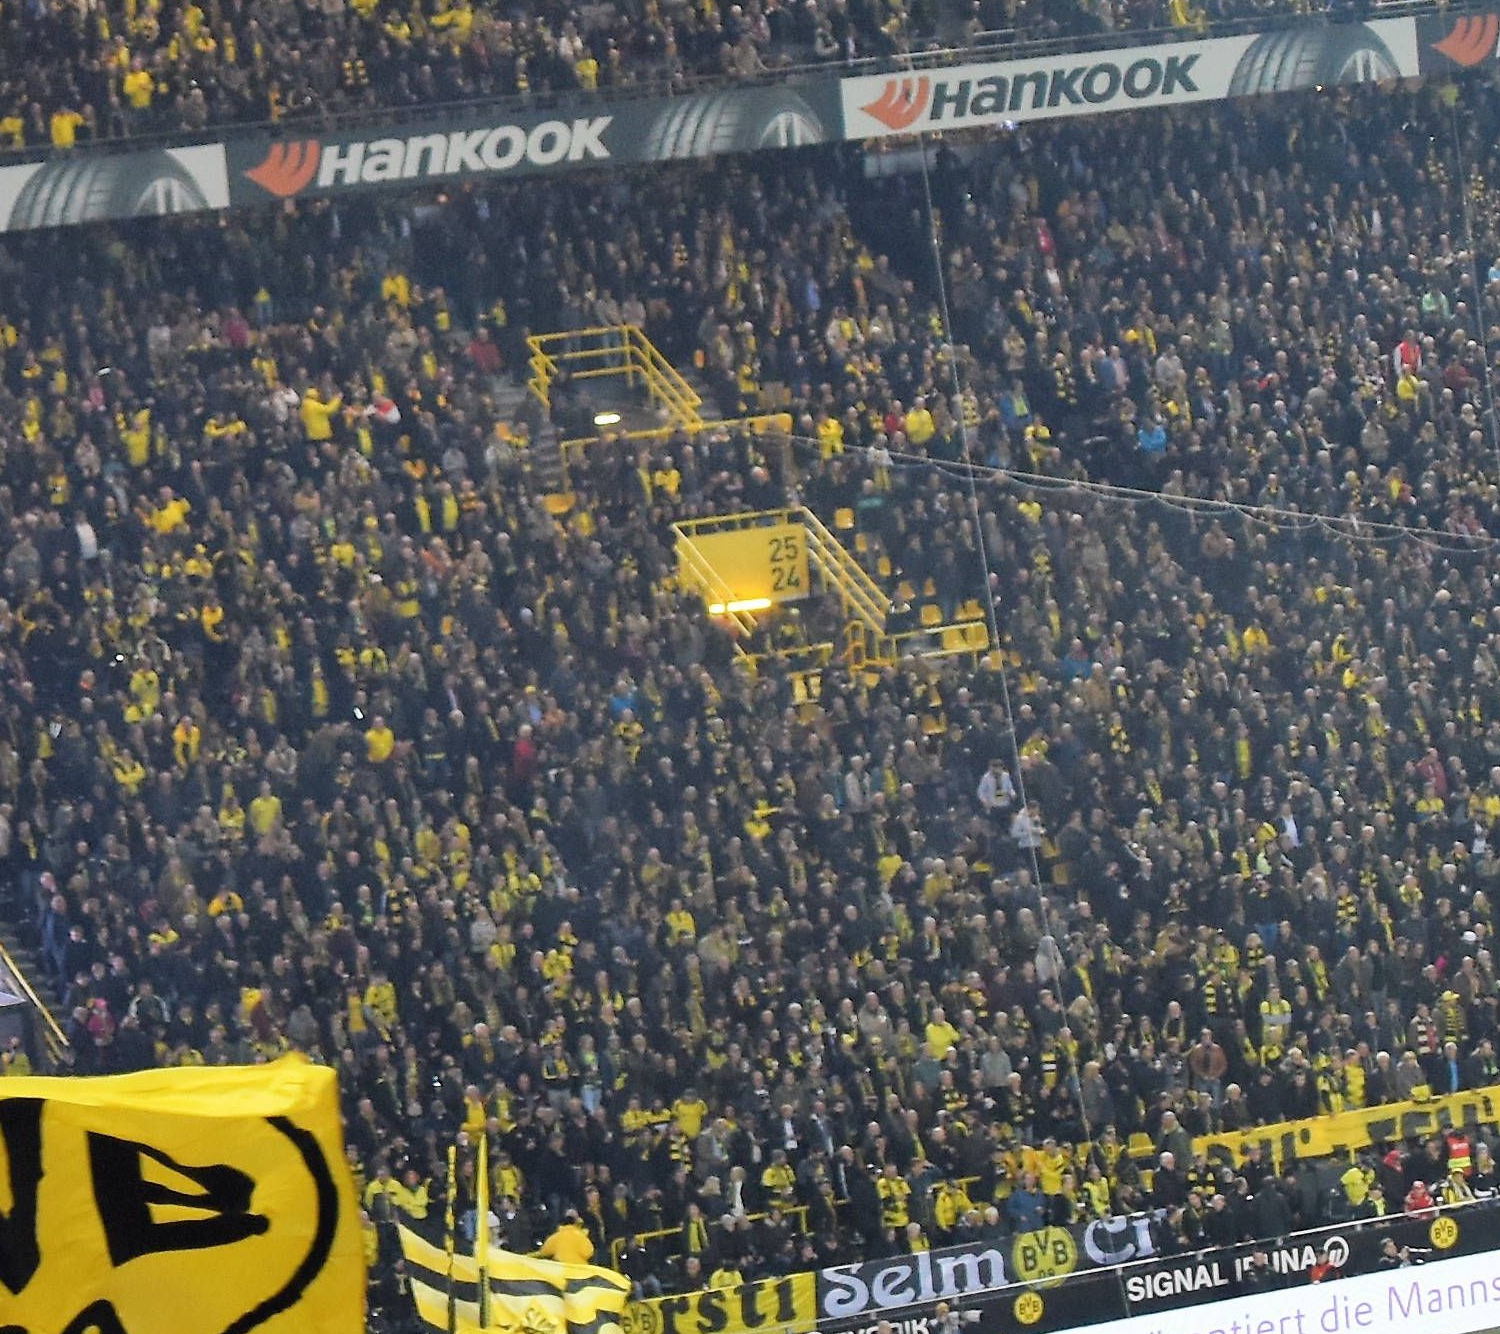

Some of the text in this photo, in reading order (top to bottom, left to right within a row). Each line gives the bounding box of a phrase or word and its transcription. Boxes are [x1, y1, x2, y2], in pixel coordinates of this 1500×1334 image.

[769, 535, 799, 565] 25
[771, 563, 801, 593] 24
[822, 1245, 1006, 1318] Selm
[1128, 1255, 1228, 1303] SIGNAL
[1320, 1288, 1372, 1334] die
